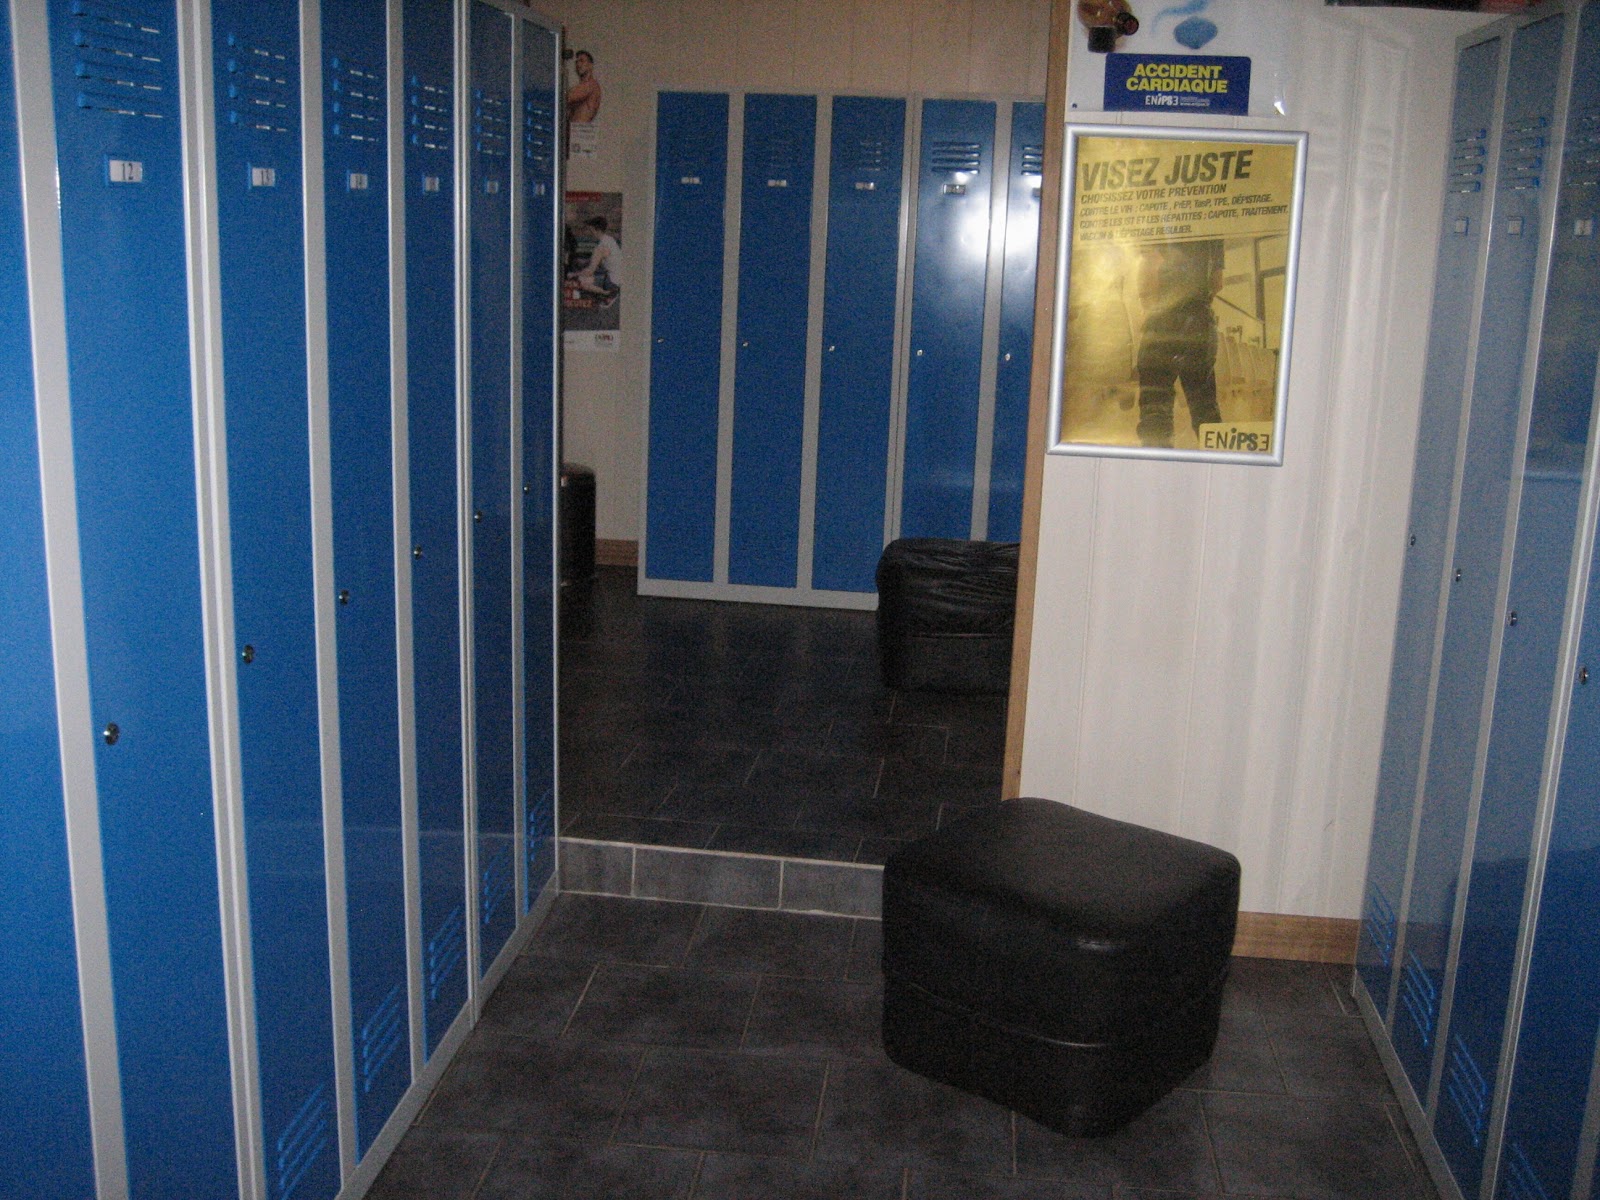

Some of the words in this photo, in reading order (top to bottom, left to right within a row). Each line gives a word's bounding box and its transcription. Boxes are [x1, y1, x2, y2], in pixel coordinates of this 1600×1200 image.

[1133, 63, 1222, 79] ACCIDENT
[1126, 77, 1228, 93] CARDIAQUE
[121, 163, 134, 181] 12
[1081, 156, 1160, 191] VISEZ
[1164, 149, 1253, 186] JUSTE
[1081, 191, 1134, 204] CHOISISSEZ
[1135, 187, 1166, 200] VOTRE
[1168, 183, 1227, 198] PRÉVENTION
[1146, 214, 1160, 224] LES
